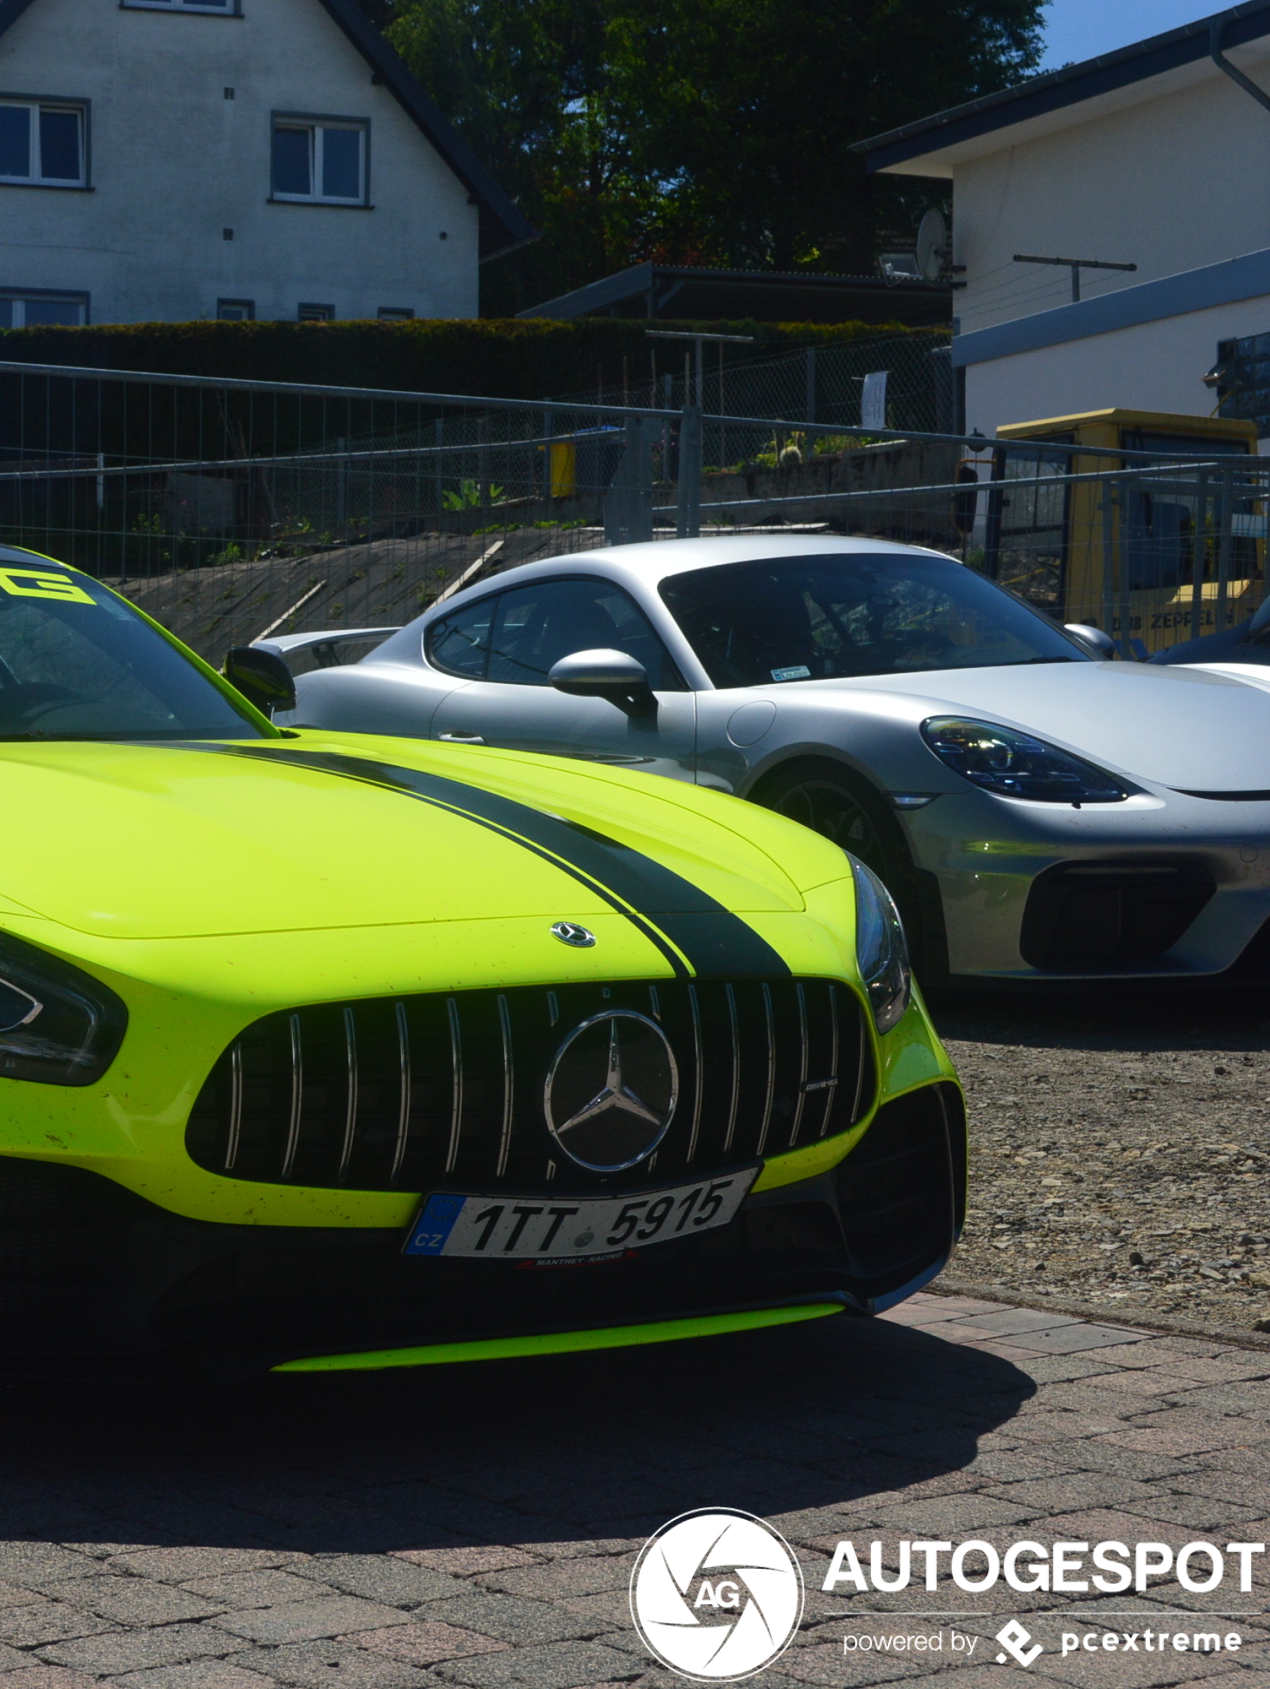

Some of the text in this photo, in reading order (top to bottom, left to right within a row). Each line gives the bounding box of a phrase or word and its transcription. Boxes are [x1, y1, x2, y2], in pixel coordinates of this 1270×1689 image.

[1150, 607, 1235, 629] ZEPPELN
[473, 1179, 734, 1252] 1TT 5915
[414, 1233, 443, 1248] CZ
